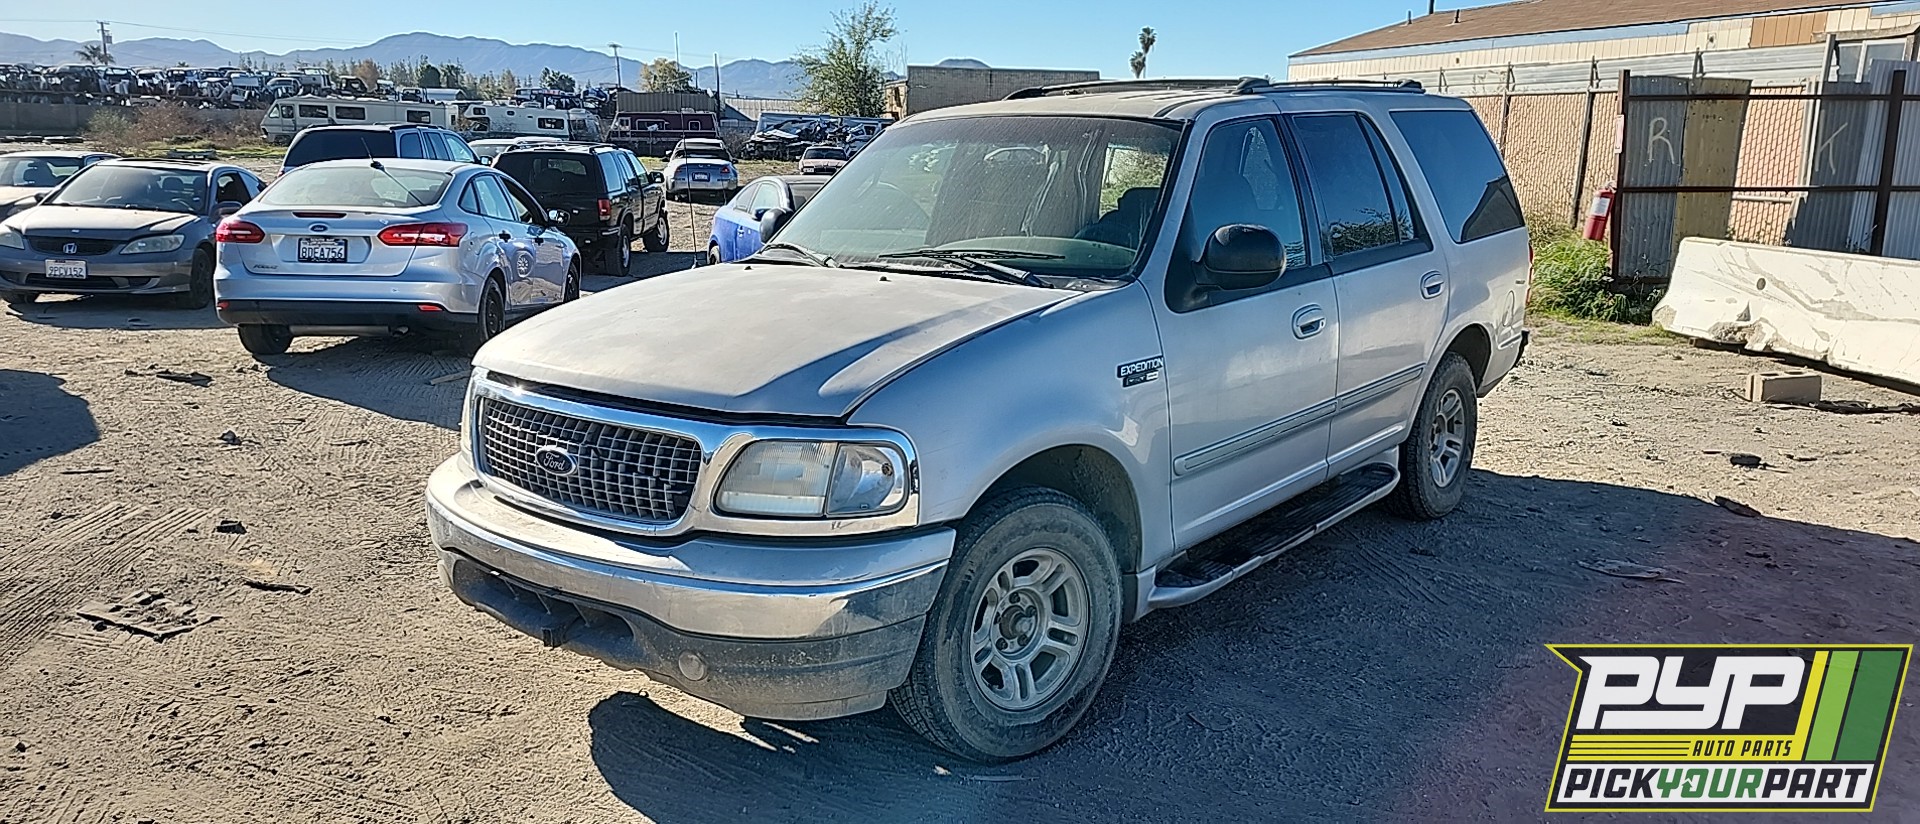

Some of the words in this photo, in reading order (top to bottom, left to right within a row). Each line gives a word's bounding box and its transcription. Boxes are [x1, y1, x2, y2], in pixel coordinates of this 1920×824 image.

[1648, 116, 1675, 164] R
[301, 246, 343, 259] 8DEA756
[1120, 357, 1164, 376] EXPEDITION
[543, 451, 566, 470] Ford
